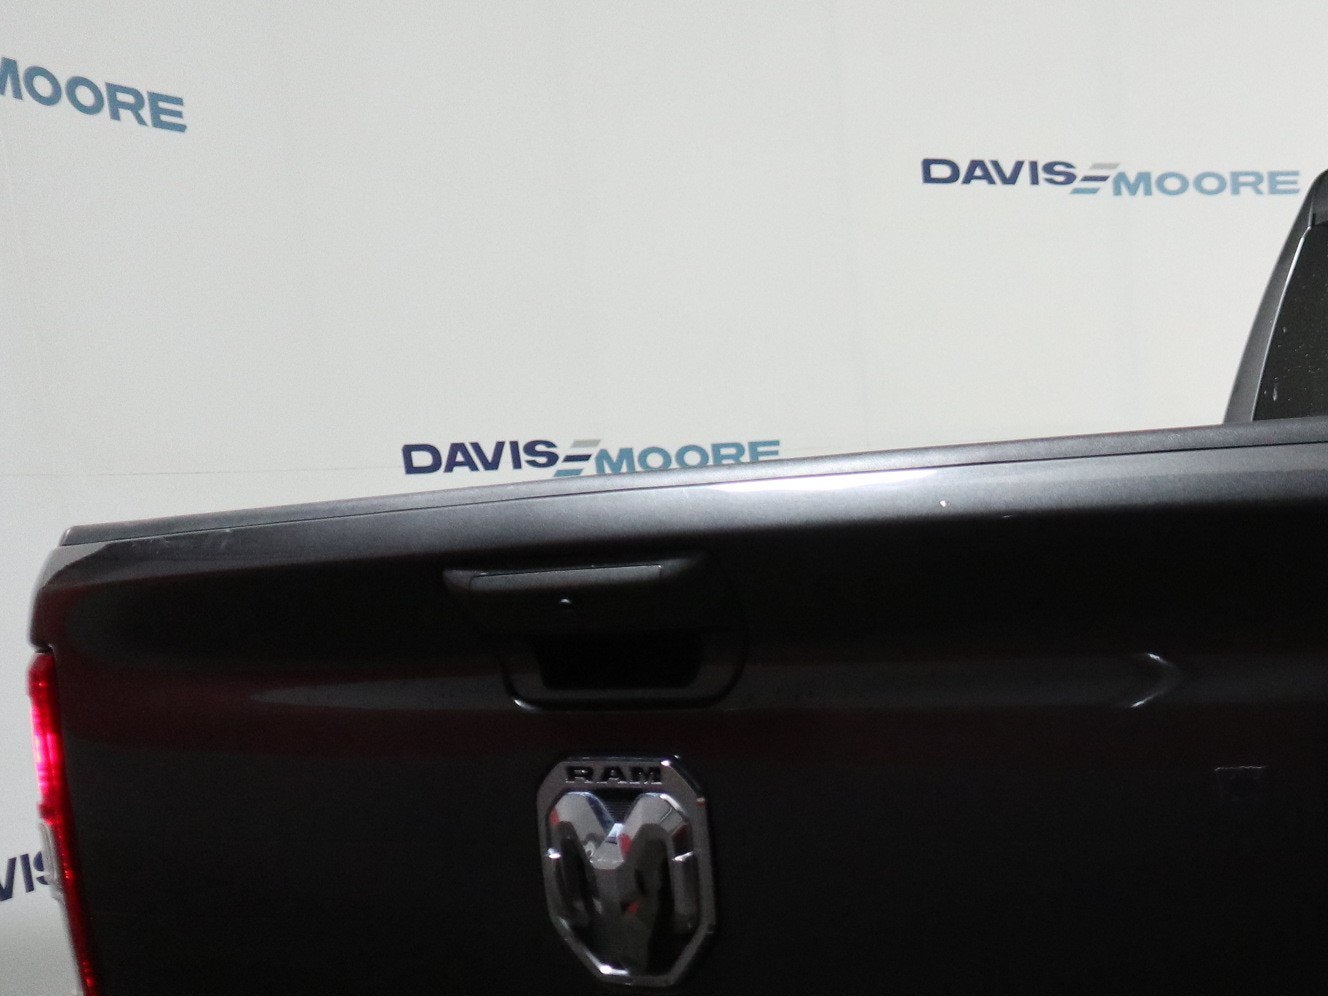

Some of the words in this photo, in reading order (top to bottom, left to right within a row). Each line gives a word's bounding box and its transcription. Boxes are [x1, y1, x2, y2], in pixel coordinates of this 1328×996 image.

[920, 158, 1078, 186] DAVIS
[1112, 169, 1301, 197] MOORE
[401, 439, 559, 476] DAVIS
[594, 440, 781, 475] MOORE
[565, 765, 663, 785] RAM
